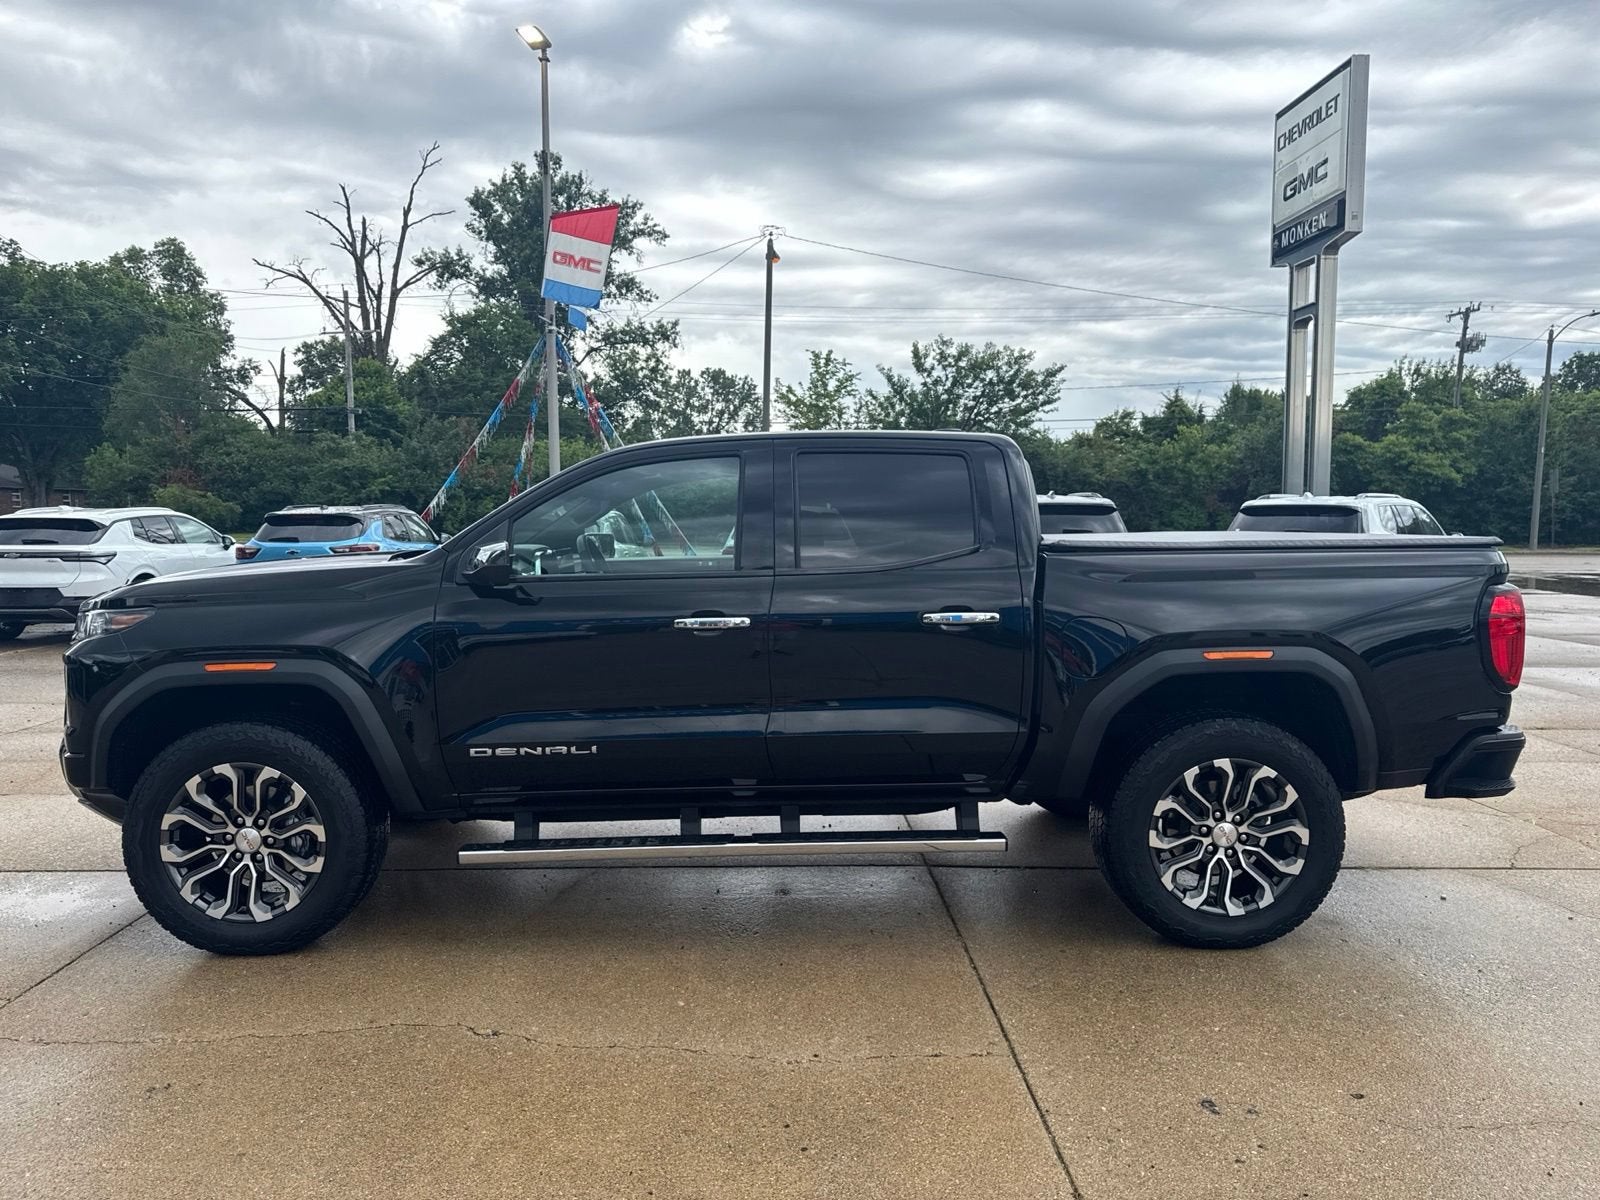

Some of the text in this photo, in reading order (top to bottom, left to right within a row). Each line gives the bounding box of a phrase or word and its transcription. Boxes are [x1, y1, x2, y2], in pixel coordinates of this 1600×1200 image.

[1277, 93, 1340, 152] CHEVROLET
[1282, 157, 1328, 201] GMC
[1281, 211, 1327, 248] MONKEN
[552, 250, 602, 274] GMC
[469, 745, 598, 757] DENALI
